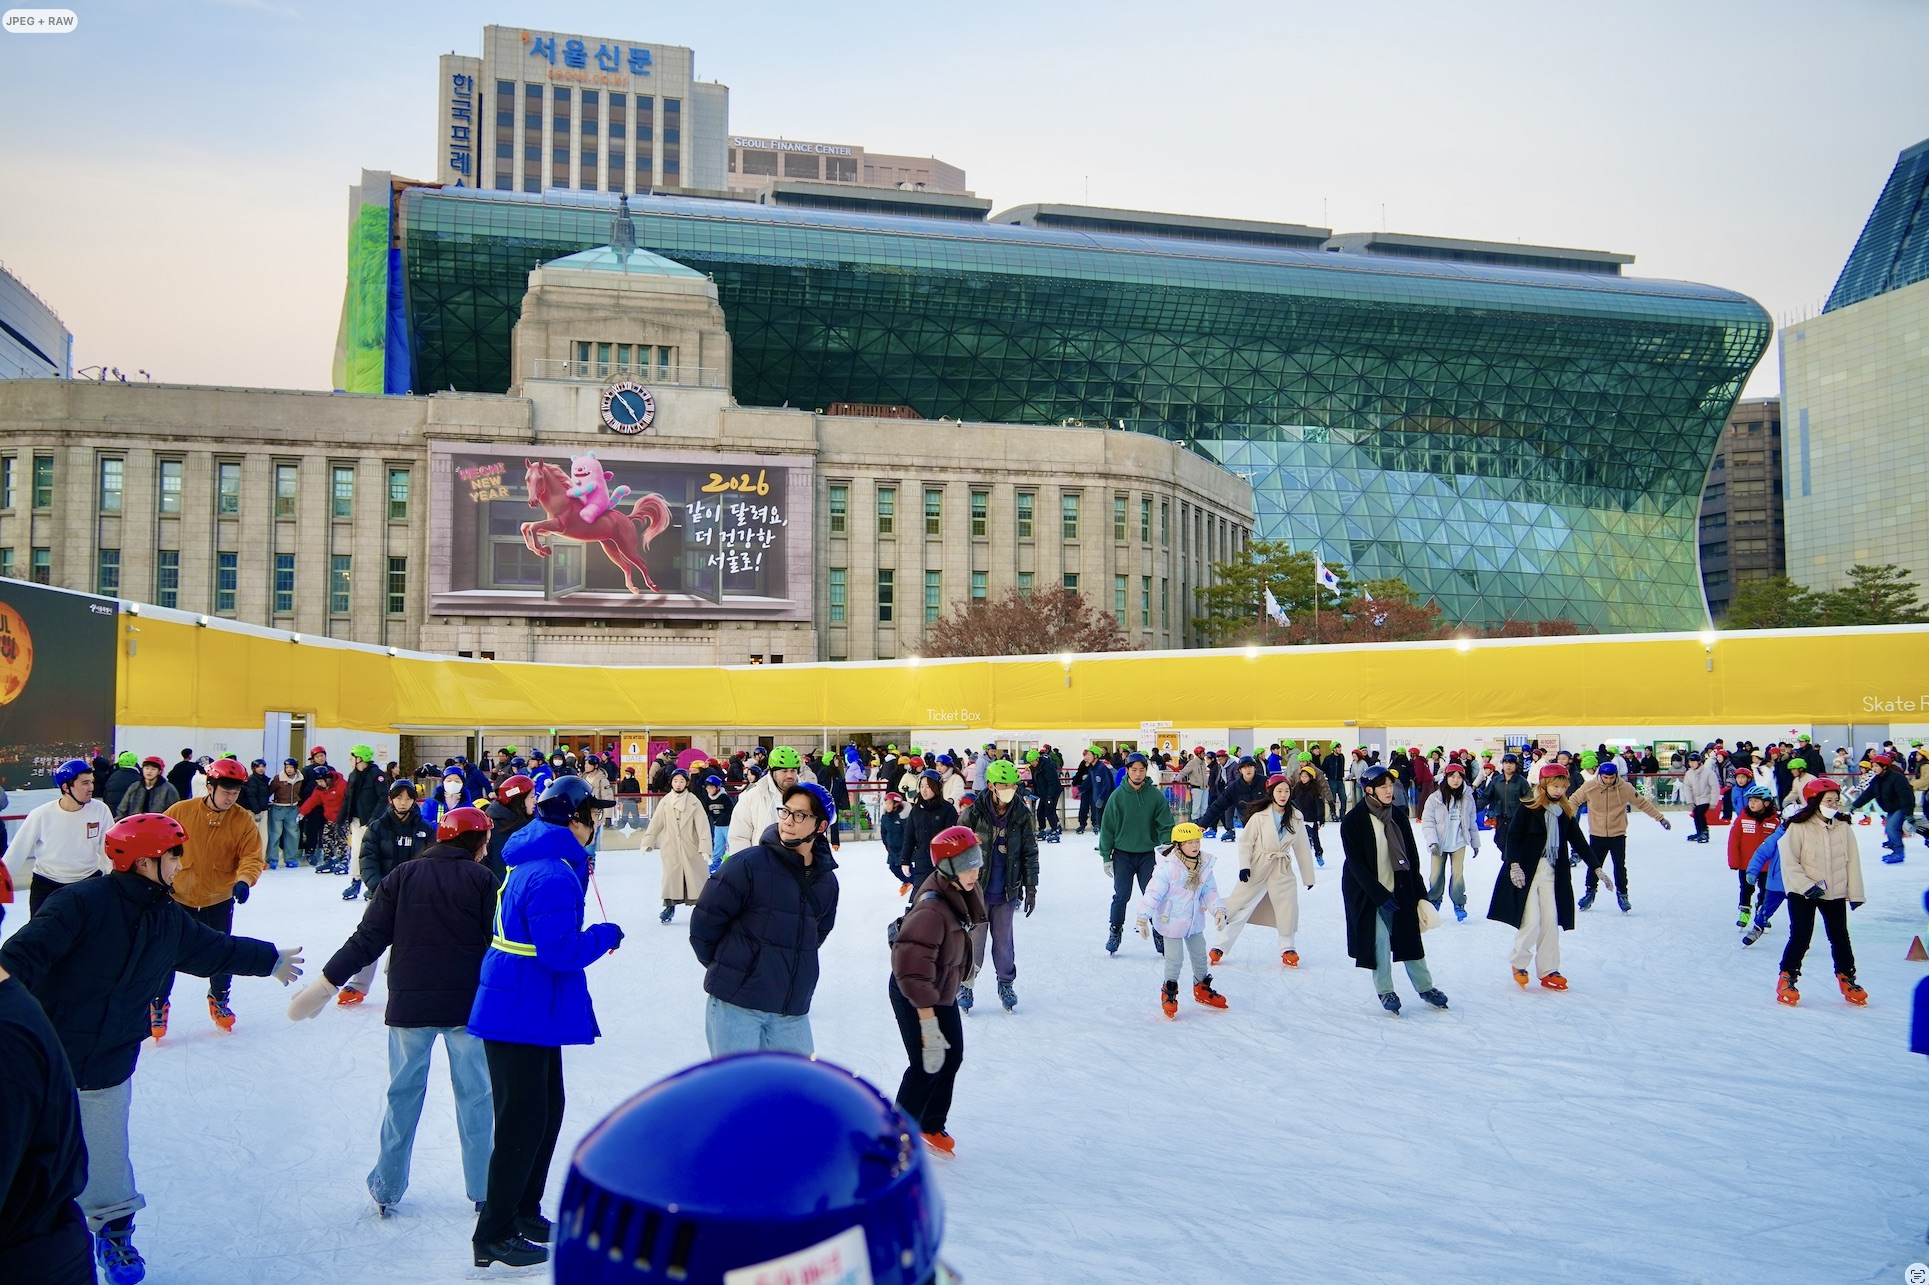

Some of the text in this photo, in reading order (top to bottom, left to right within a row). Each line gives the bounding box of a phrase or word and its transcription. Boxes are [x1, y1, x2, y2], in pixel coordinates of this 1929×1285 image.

[529, 36, 653, 76] 서울신문
[547, 67, 629, 88] seoul.co.kr
[734, 137, 852, 157] SEOUL FINANCE CENTER
[471, 475, 502, 490] NEW
[701, 469, 770, 497] 2026
[469, 486, 510, 503] YEAR
[686, 500, 788, 527] 같이 달려요,
[695, 527, 776, 549] 더 건강한
[707, 549, 763, 574] 서울로!
[1862, 695, 1917, 713] Skate
[926, 708, 981, 722] Ticket Box
[1165, 741, 1170, 749] 2
